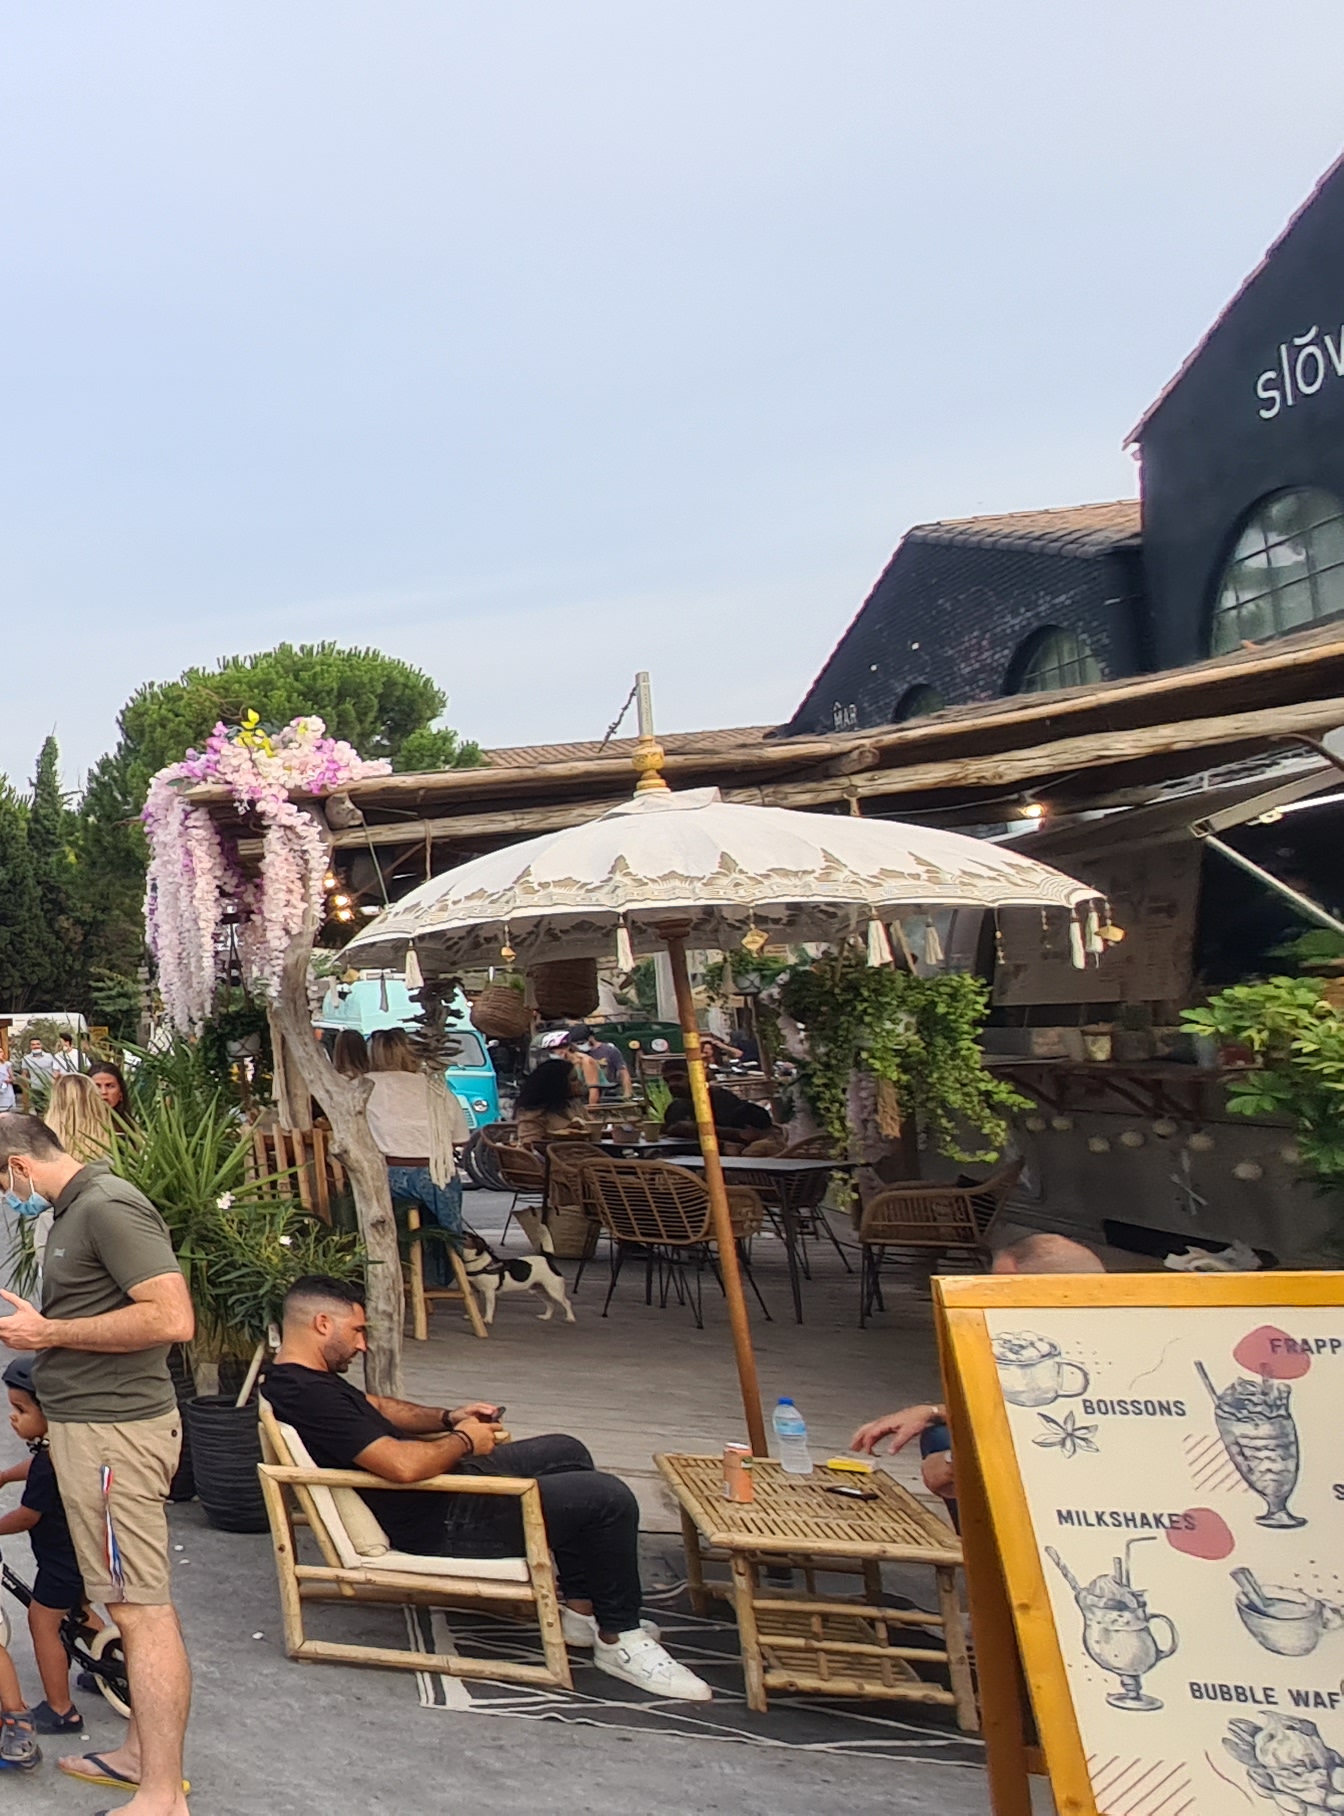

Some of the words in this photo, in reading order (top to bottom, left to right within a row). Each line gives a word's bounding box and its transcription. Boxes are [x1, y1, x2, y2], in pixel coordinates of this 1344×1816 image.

[1270, 1338, 1343, 1355] FRAPP
[1082, 1399, 1187, 1417] BOISSONS
[1056, 1509, 1197, 1531] MILKSHAKES
[1189, 1681, 1279, 1706] BUBBLE
[1288, 1688, 1341, 1710] WAF
